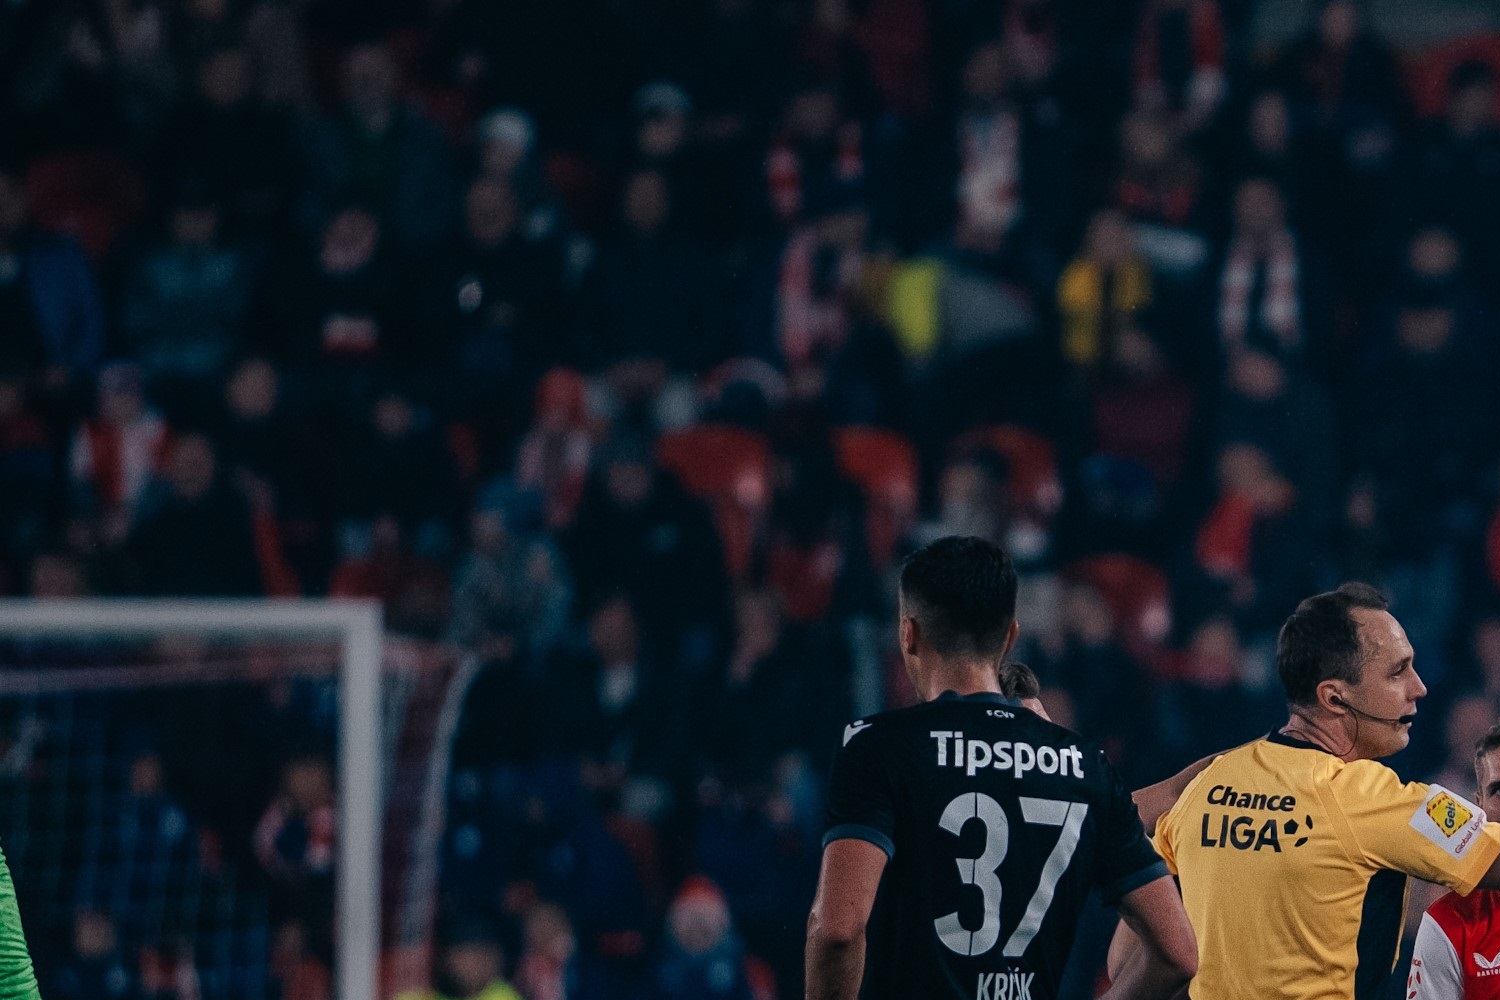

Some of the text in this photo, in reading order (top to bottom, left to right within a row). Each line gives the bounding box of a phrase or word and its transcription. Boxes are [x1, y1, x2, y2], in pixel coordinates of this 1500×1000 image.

[930, 730, 1085, 779] Tipsport
[1206, 784, 1296, 813] Chance
[1200, 813, 1282, 854] LIGA
[933, 791, 1089, 957] 37
